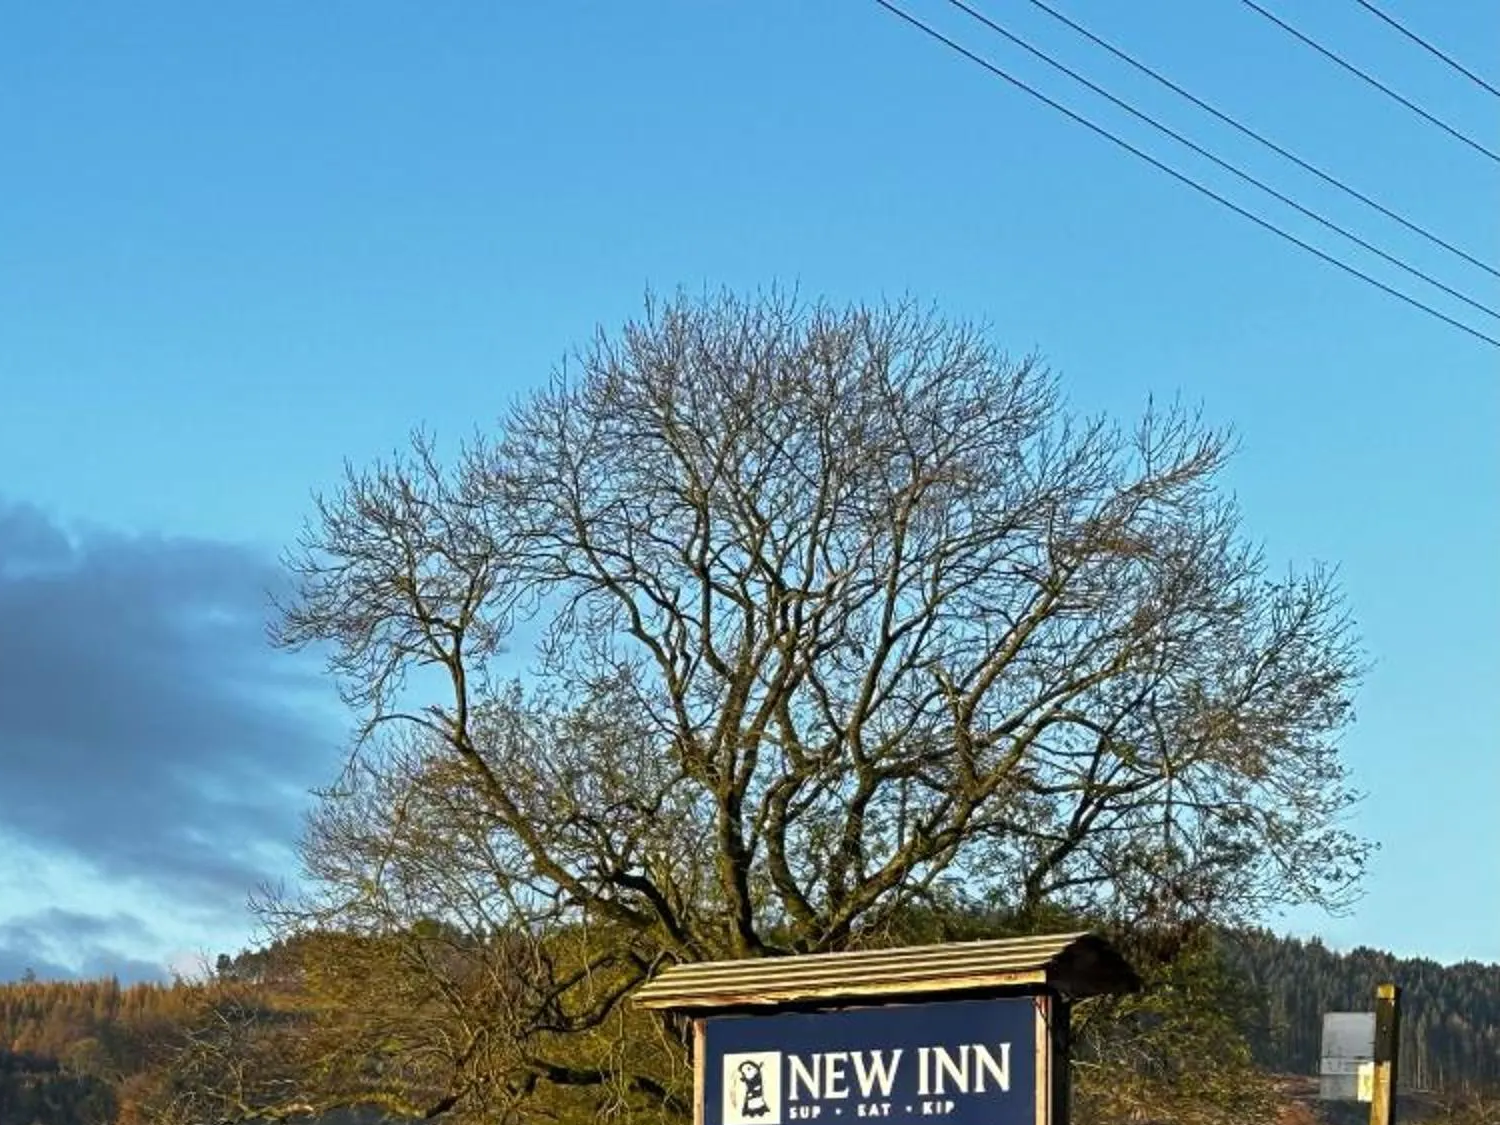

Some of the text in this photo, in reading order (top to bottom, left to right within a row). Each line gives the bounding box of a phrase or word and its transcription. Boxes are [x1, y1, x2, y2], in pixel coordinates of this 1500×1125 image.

[788, 1043, 1012, 1100] NEW INN
[789, 1101, 955, 1119] SUP EAT KIP
